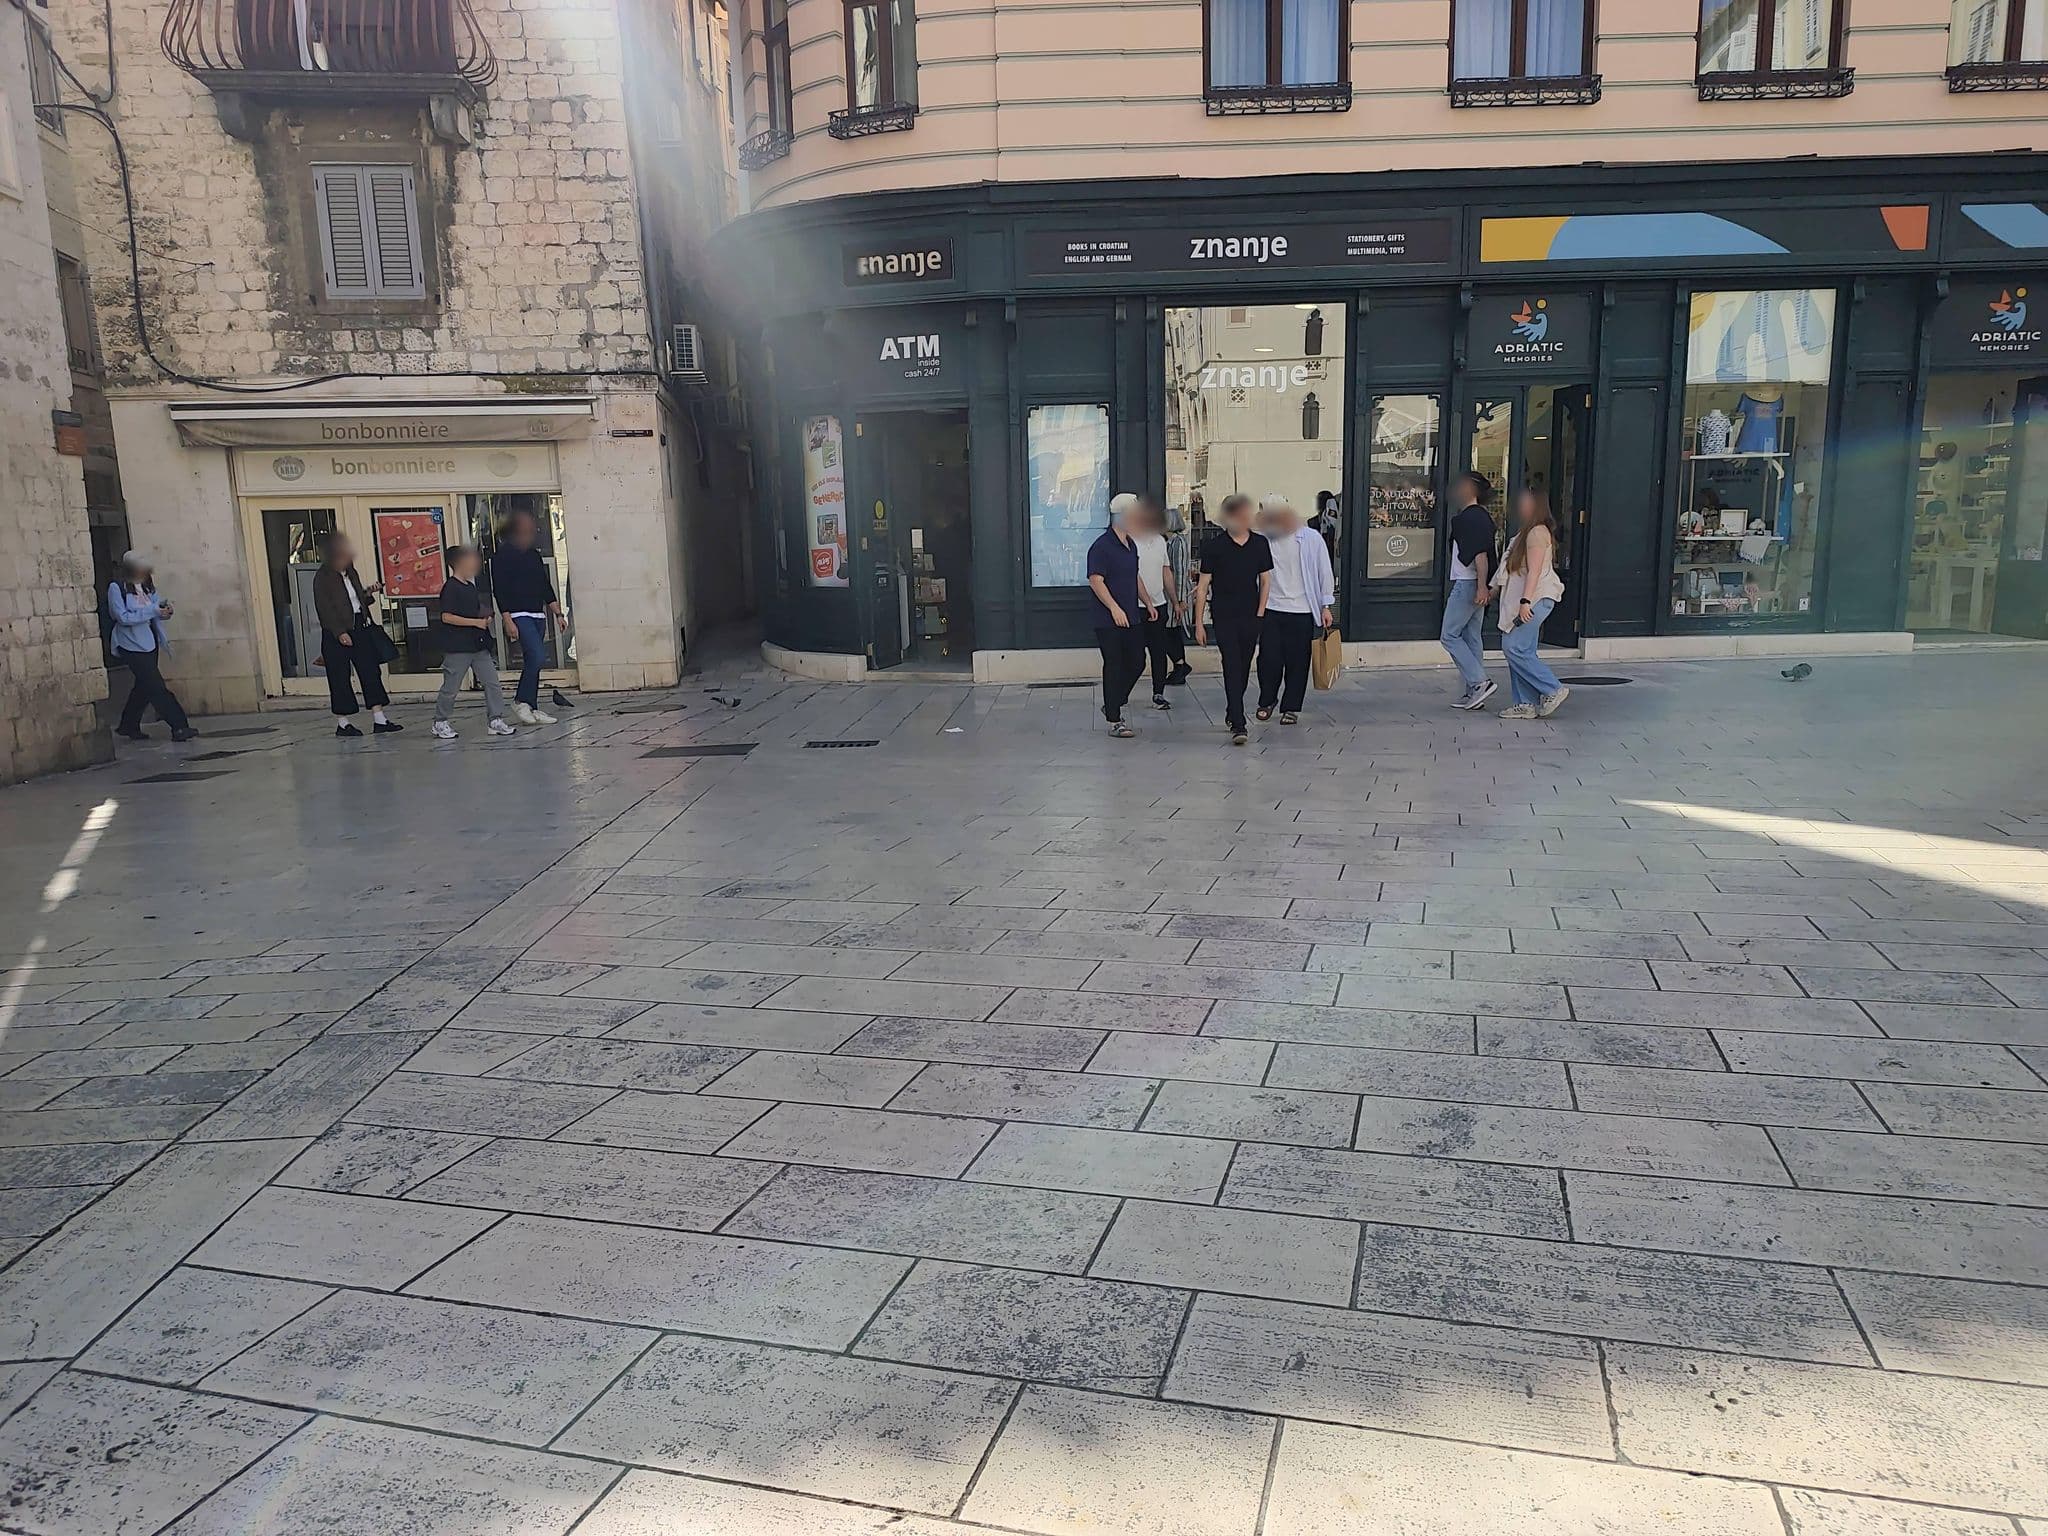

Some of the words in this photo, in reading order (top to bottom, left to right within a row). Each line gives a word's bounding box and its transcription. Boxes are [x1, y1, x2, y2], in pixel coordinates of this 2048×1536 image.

[1347, 235, 1386, 243] STATIONERY,
[1387, 234, 1405, 242] GIFTS
[1067, 243, 1088, 251] BOOKS
[1090, 243, 1097, 251] IN
[1098, 242, 1129, 250] CROATIAN
[1190, 235, 1288, 263] znanje
[1347, 246, 1388, 255] MULTIMEDIA,
[1390, 245, 1405, 254] TOYS
[1064, 255, 1090, 263] ENGLISH
[1091, 254, 1105, 262] AND
[1106, 254, 1133, 262] GERMAN
[1971, 331, 2041, 342] ADRIATIC
[880, 334, 940, 360] ATM
[1494, 342, 1564, 354] ADRIATIC
[1979, 344, 2030, 352] MEMORIES
[917, 359, 940, 367] inside
[1503, 355, 1553, 363] MEMORIES
[904, 369, 922, 378] cash
[923, 367, 940, 377] 24/7
[1201, 364, 1309, 393] znanje
[321, 421, 449, 440] bonbonnière
